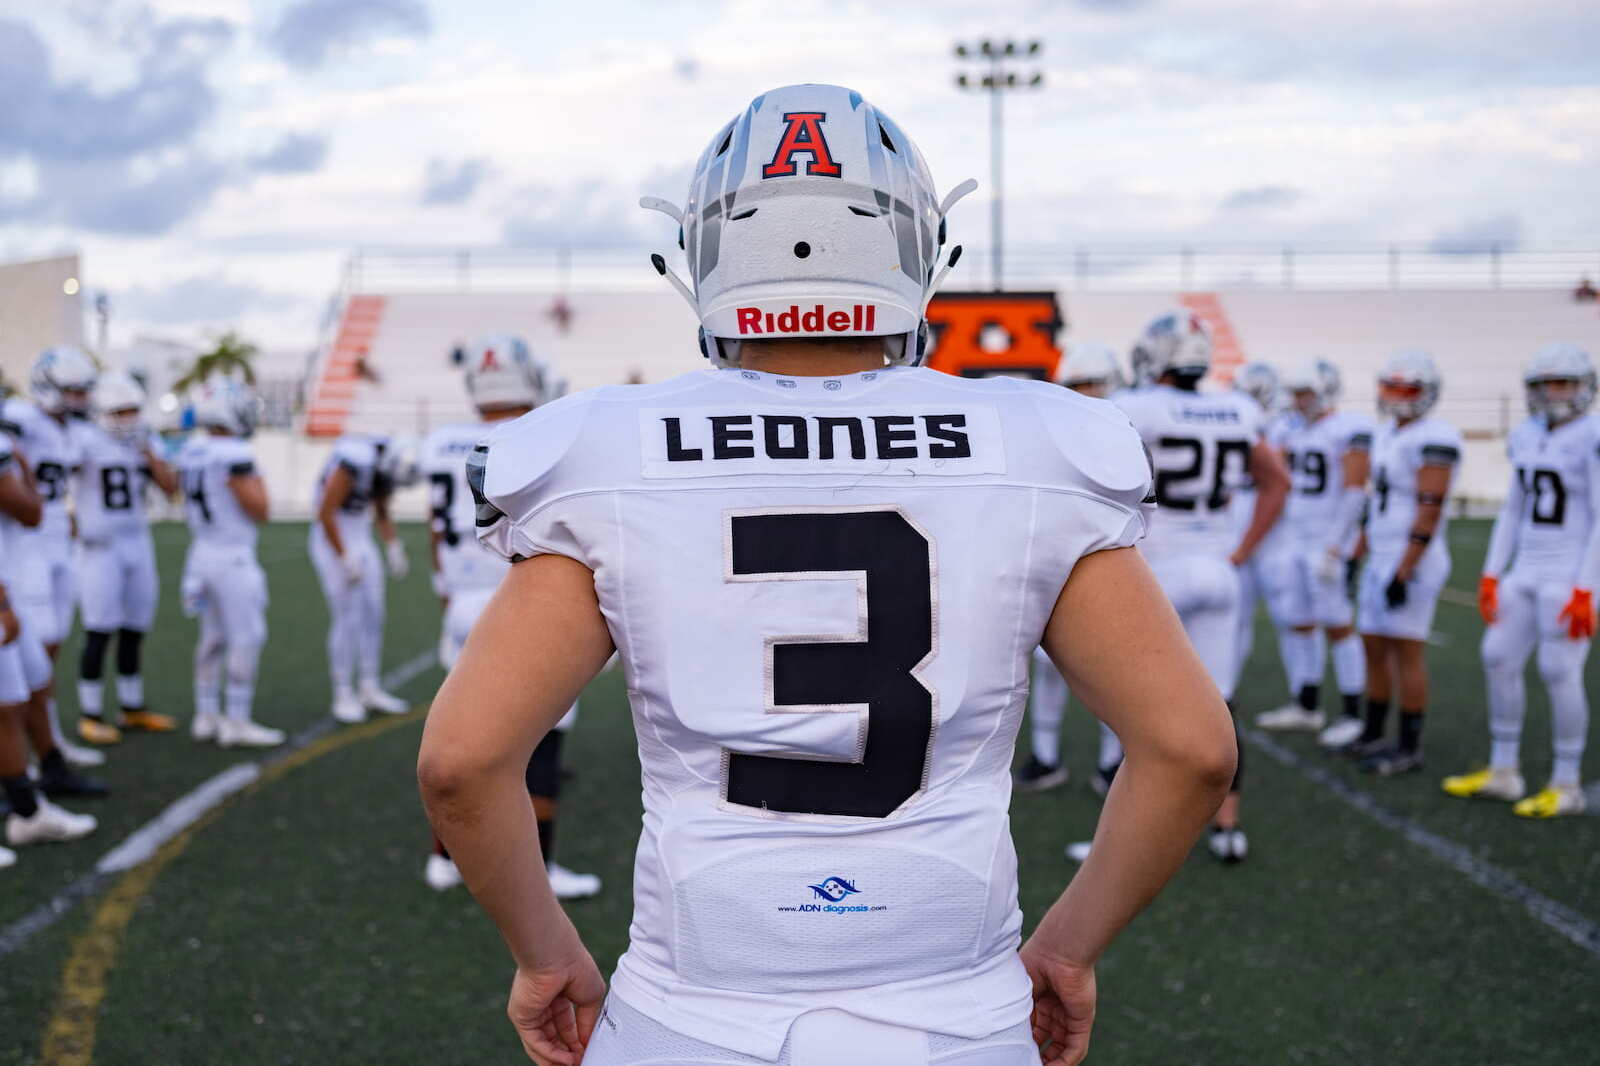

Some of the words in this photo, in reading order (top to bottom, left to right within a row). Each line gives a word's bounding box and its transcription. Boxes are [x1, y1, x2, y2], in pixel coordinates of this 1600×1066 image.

[762, 112, 842, 179] A
[736, 304, 876, 335] Riddell
[659, 414, 971, 462] LEONES
[720, 506, 938, 821] 3
